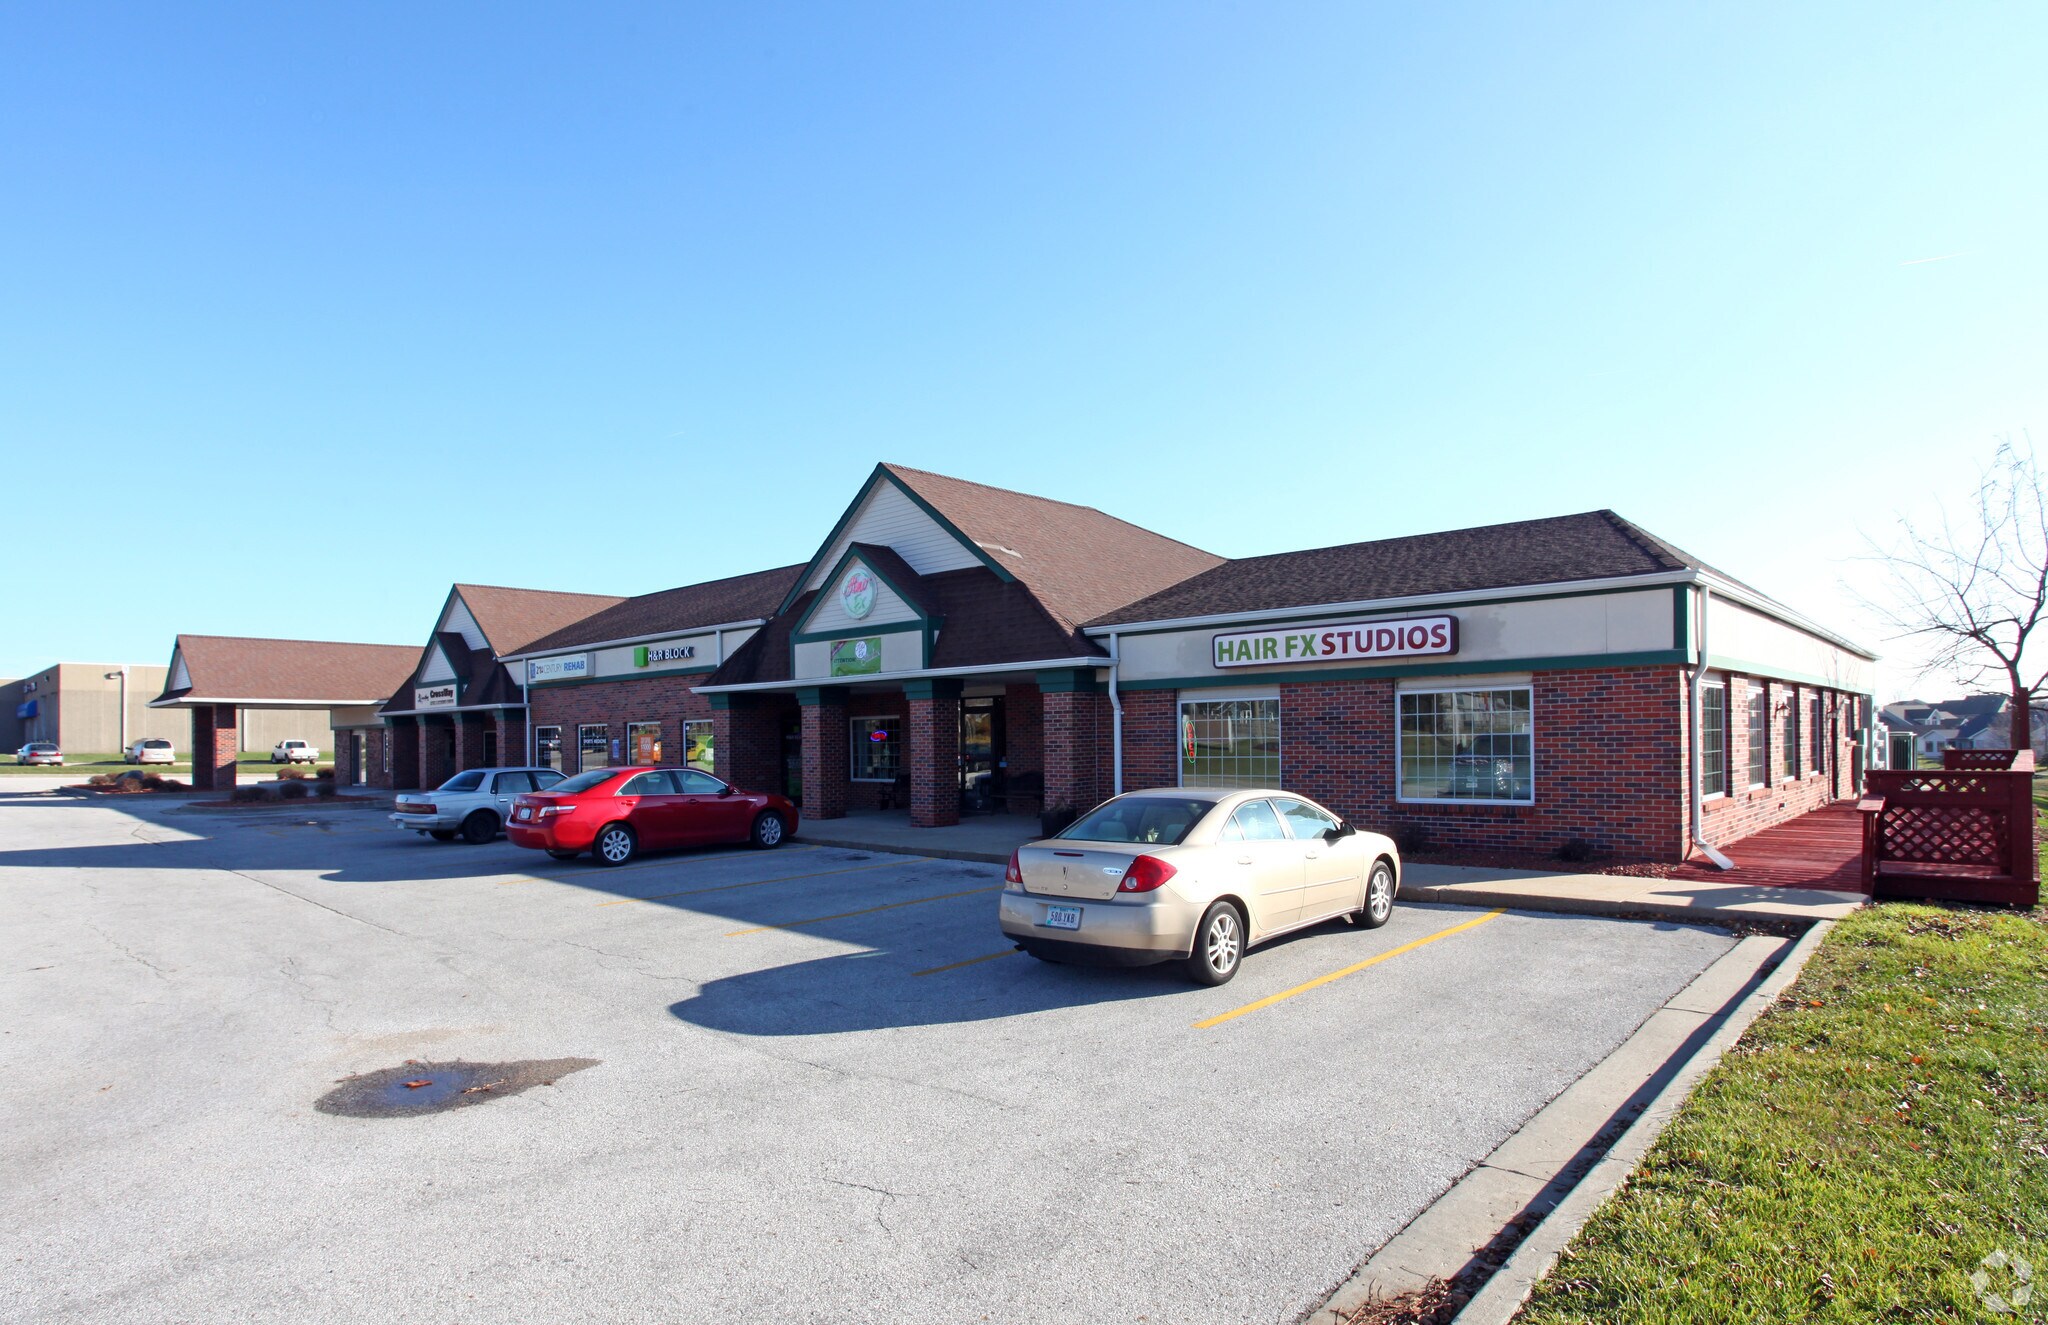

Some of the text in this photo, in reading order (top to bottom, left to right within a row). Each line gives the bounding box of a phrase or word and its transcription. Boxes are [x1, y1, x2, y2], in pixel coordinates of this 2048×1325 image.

[1218, 624, 1447, 662] HAIR FX STUDIOS
[648, 646, 690, 661] H&R BLOCK
[564, 660, 585, 671] REHAB
